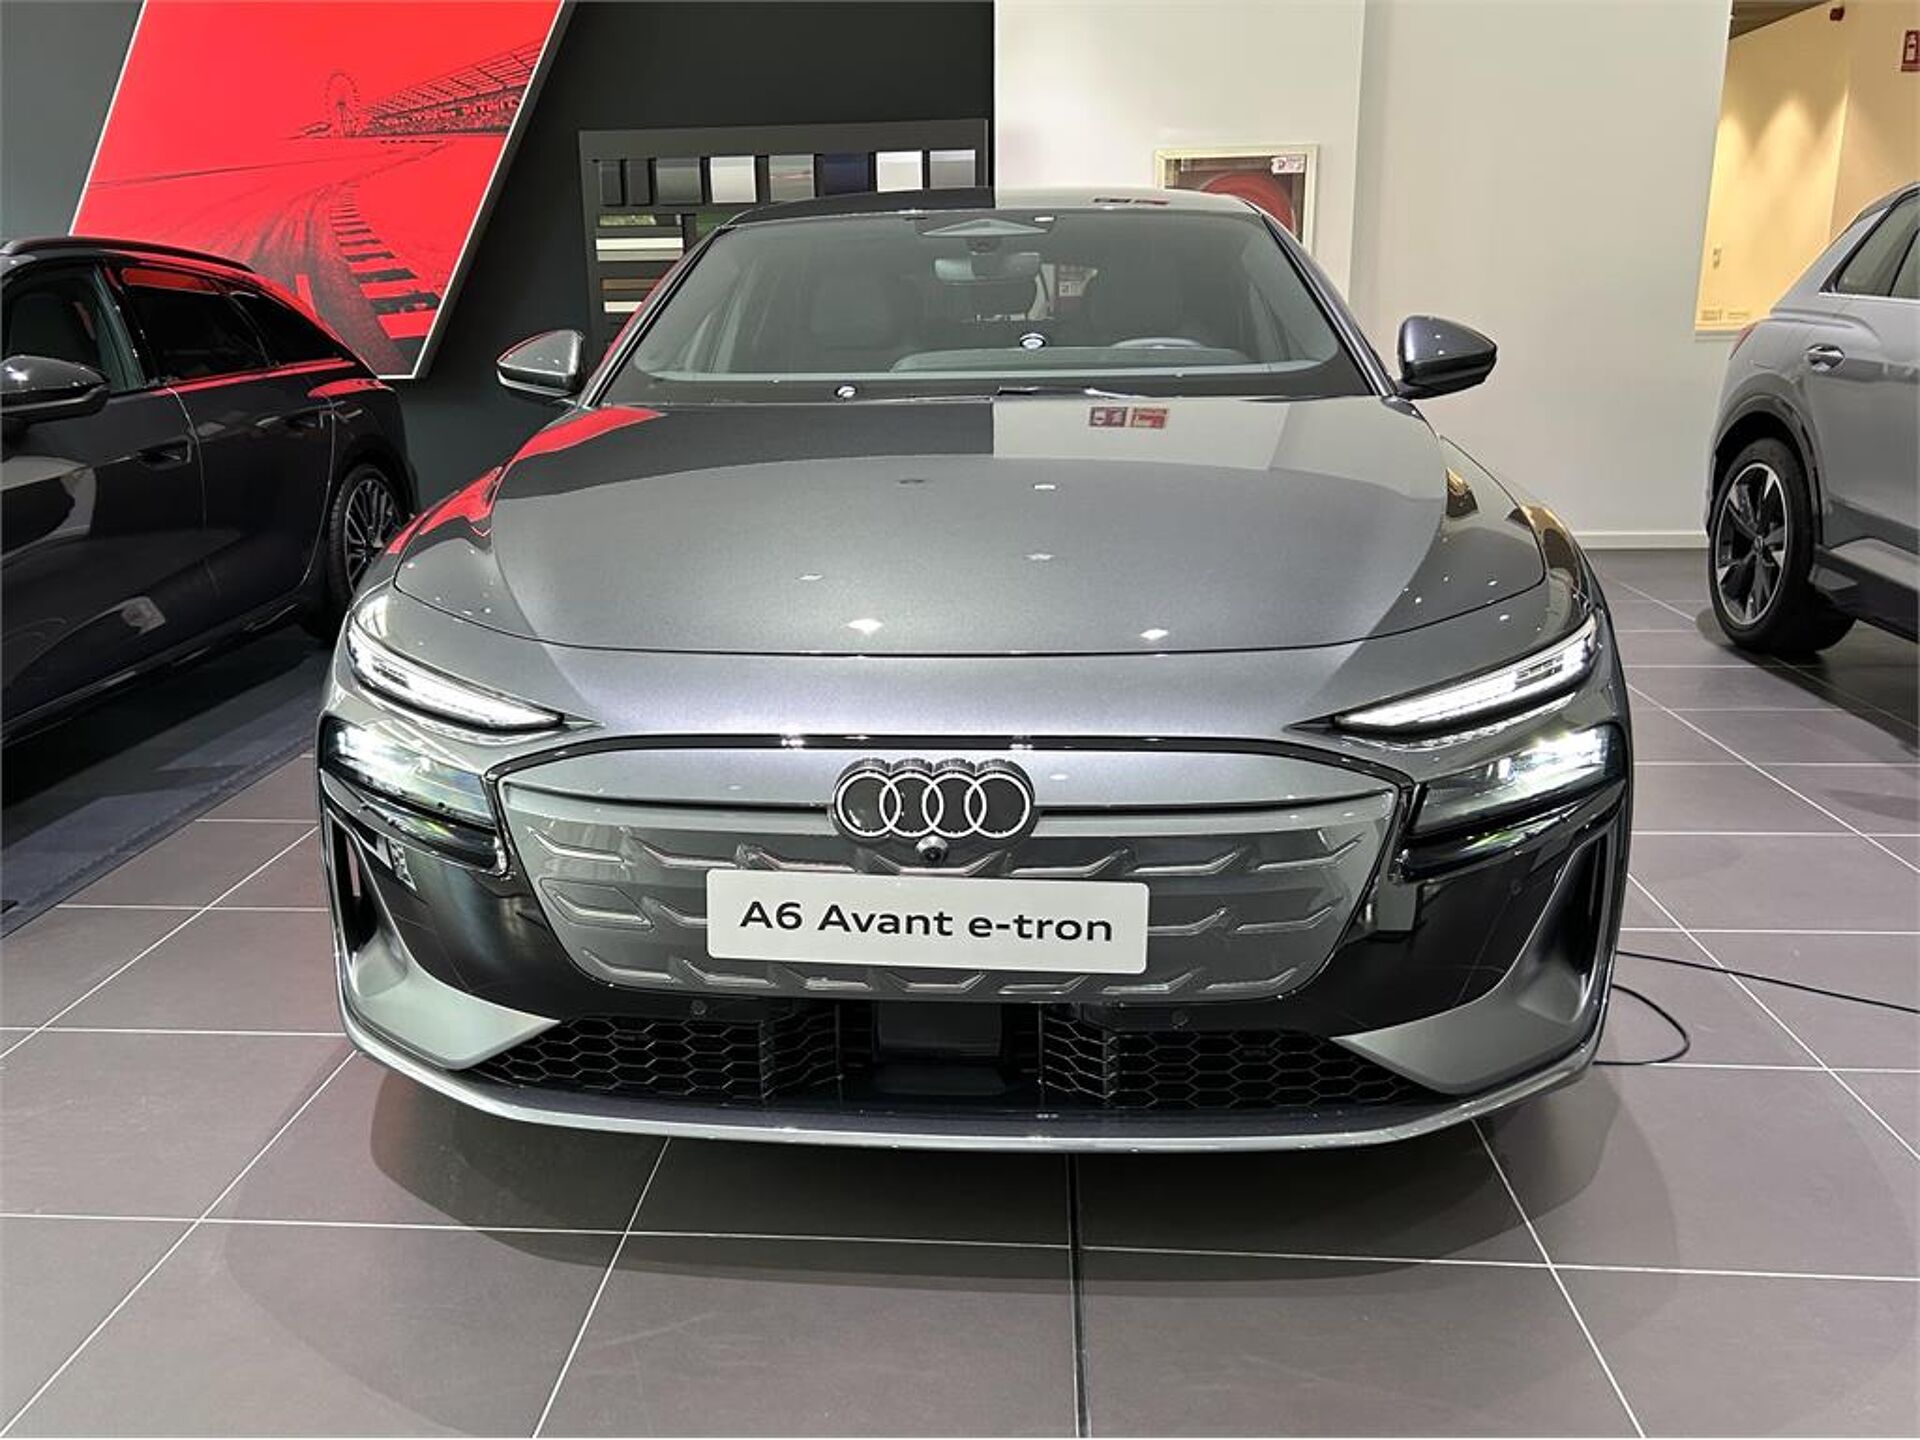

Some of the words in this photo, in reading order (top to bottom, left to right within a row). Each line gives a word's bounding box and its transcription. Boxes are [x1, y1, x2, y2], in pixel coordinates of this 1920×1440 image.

[739, 901, 803, 930] A6
[817, 904, 954, 937] Avant
[968, 914, 1113, 942] e-tron
